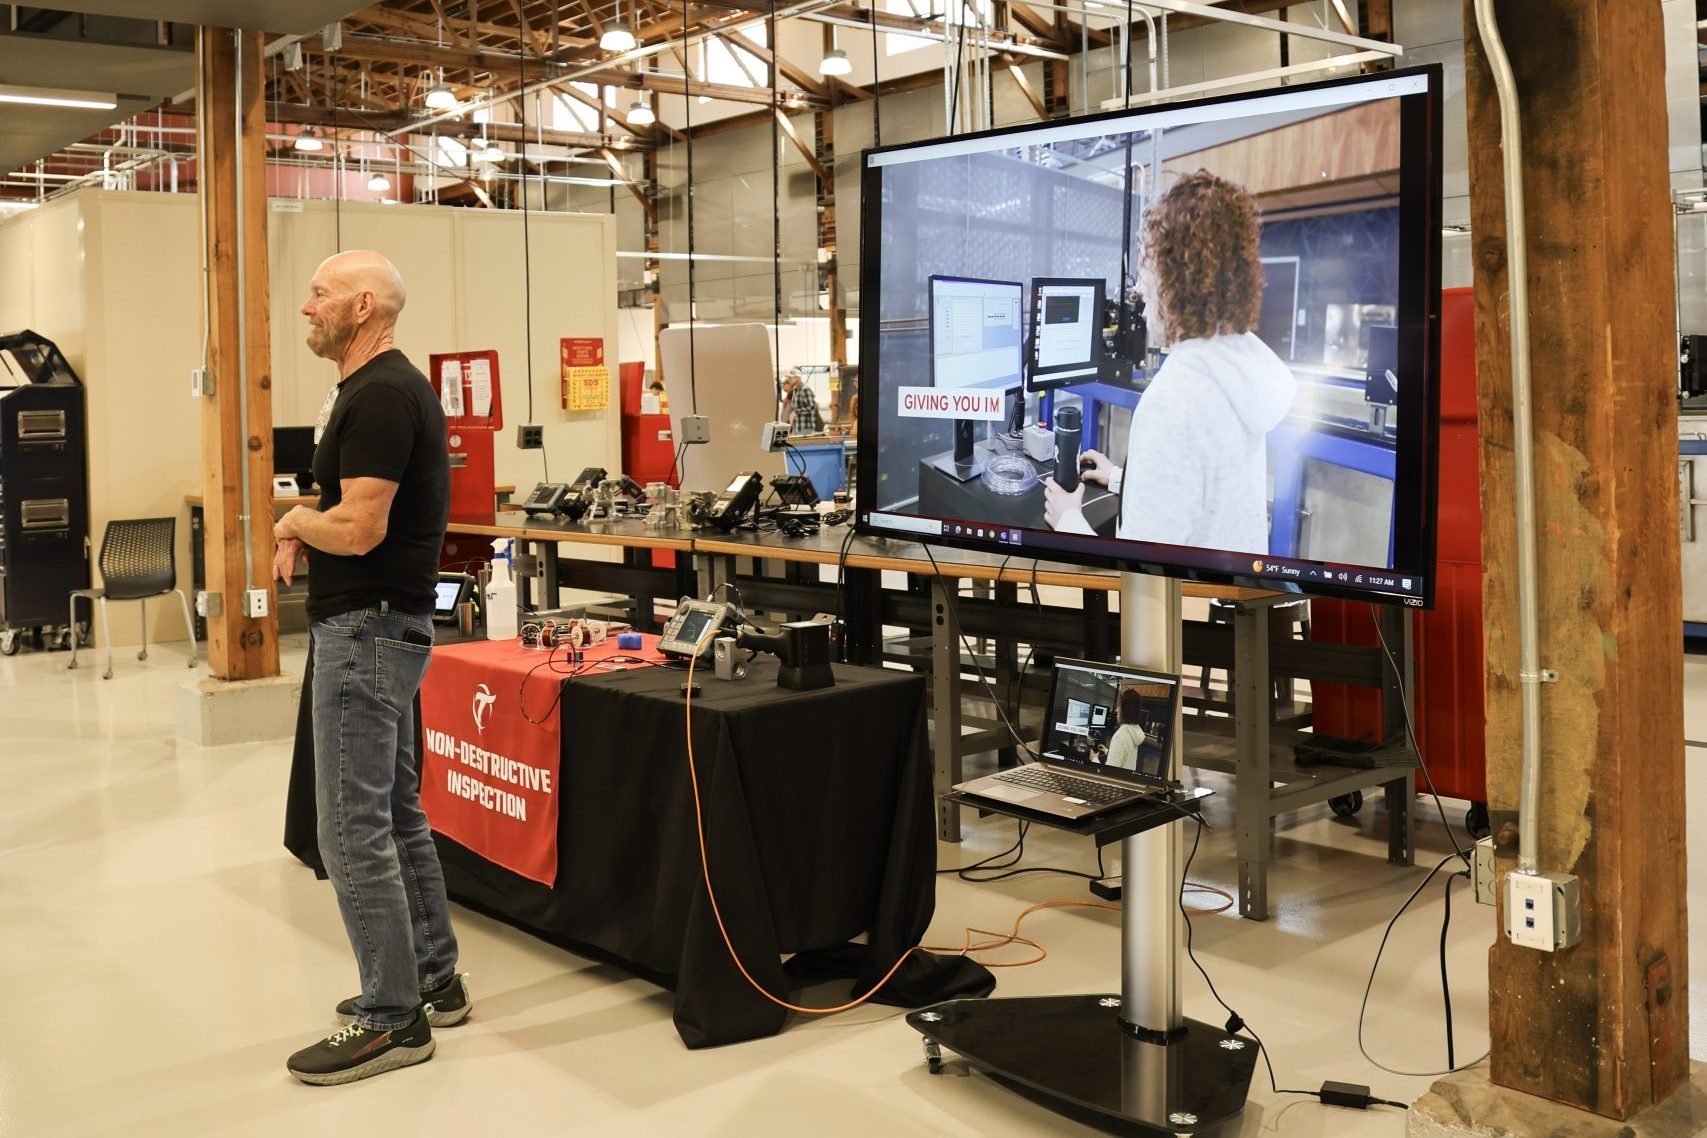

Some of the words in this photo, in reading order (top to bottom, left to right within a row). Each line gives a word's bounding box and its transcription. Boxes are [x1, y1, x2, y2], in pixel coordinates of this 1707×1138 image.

[904, 394, 949, 411] GIVING
[953, 395, 980, 412] YOU
[984, 397, 1000, 413] IM
[1281, 566, 1301, 576] Sunny
[1369, 577, 1384, 585] 11:27
[1384, 578, 1394, 586] AM
[1403, 598, 1424, 607] VIZIO
[425, 728, 552, 794] NON-DESTRUCTIVE
[447, 769, 527, 822] INSPECTION
